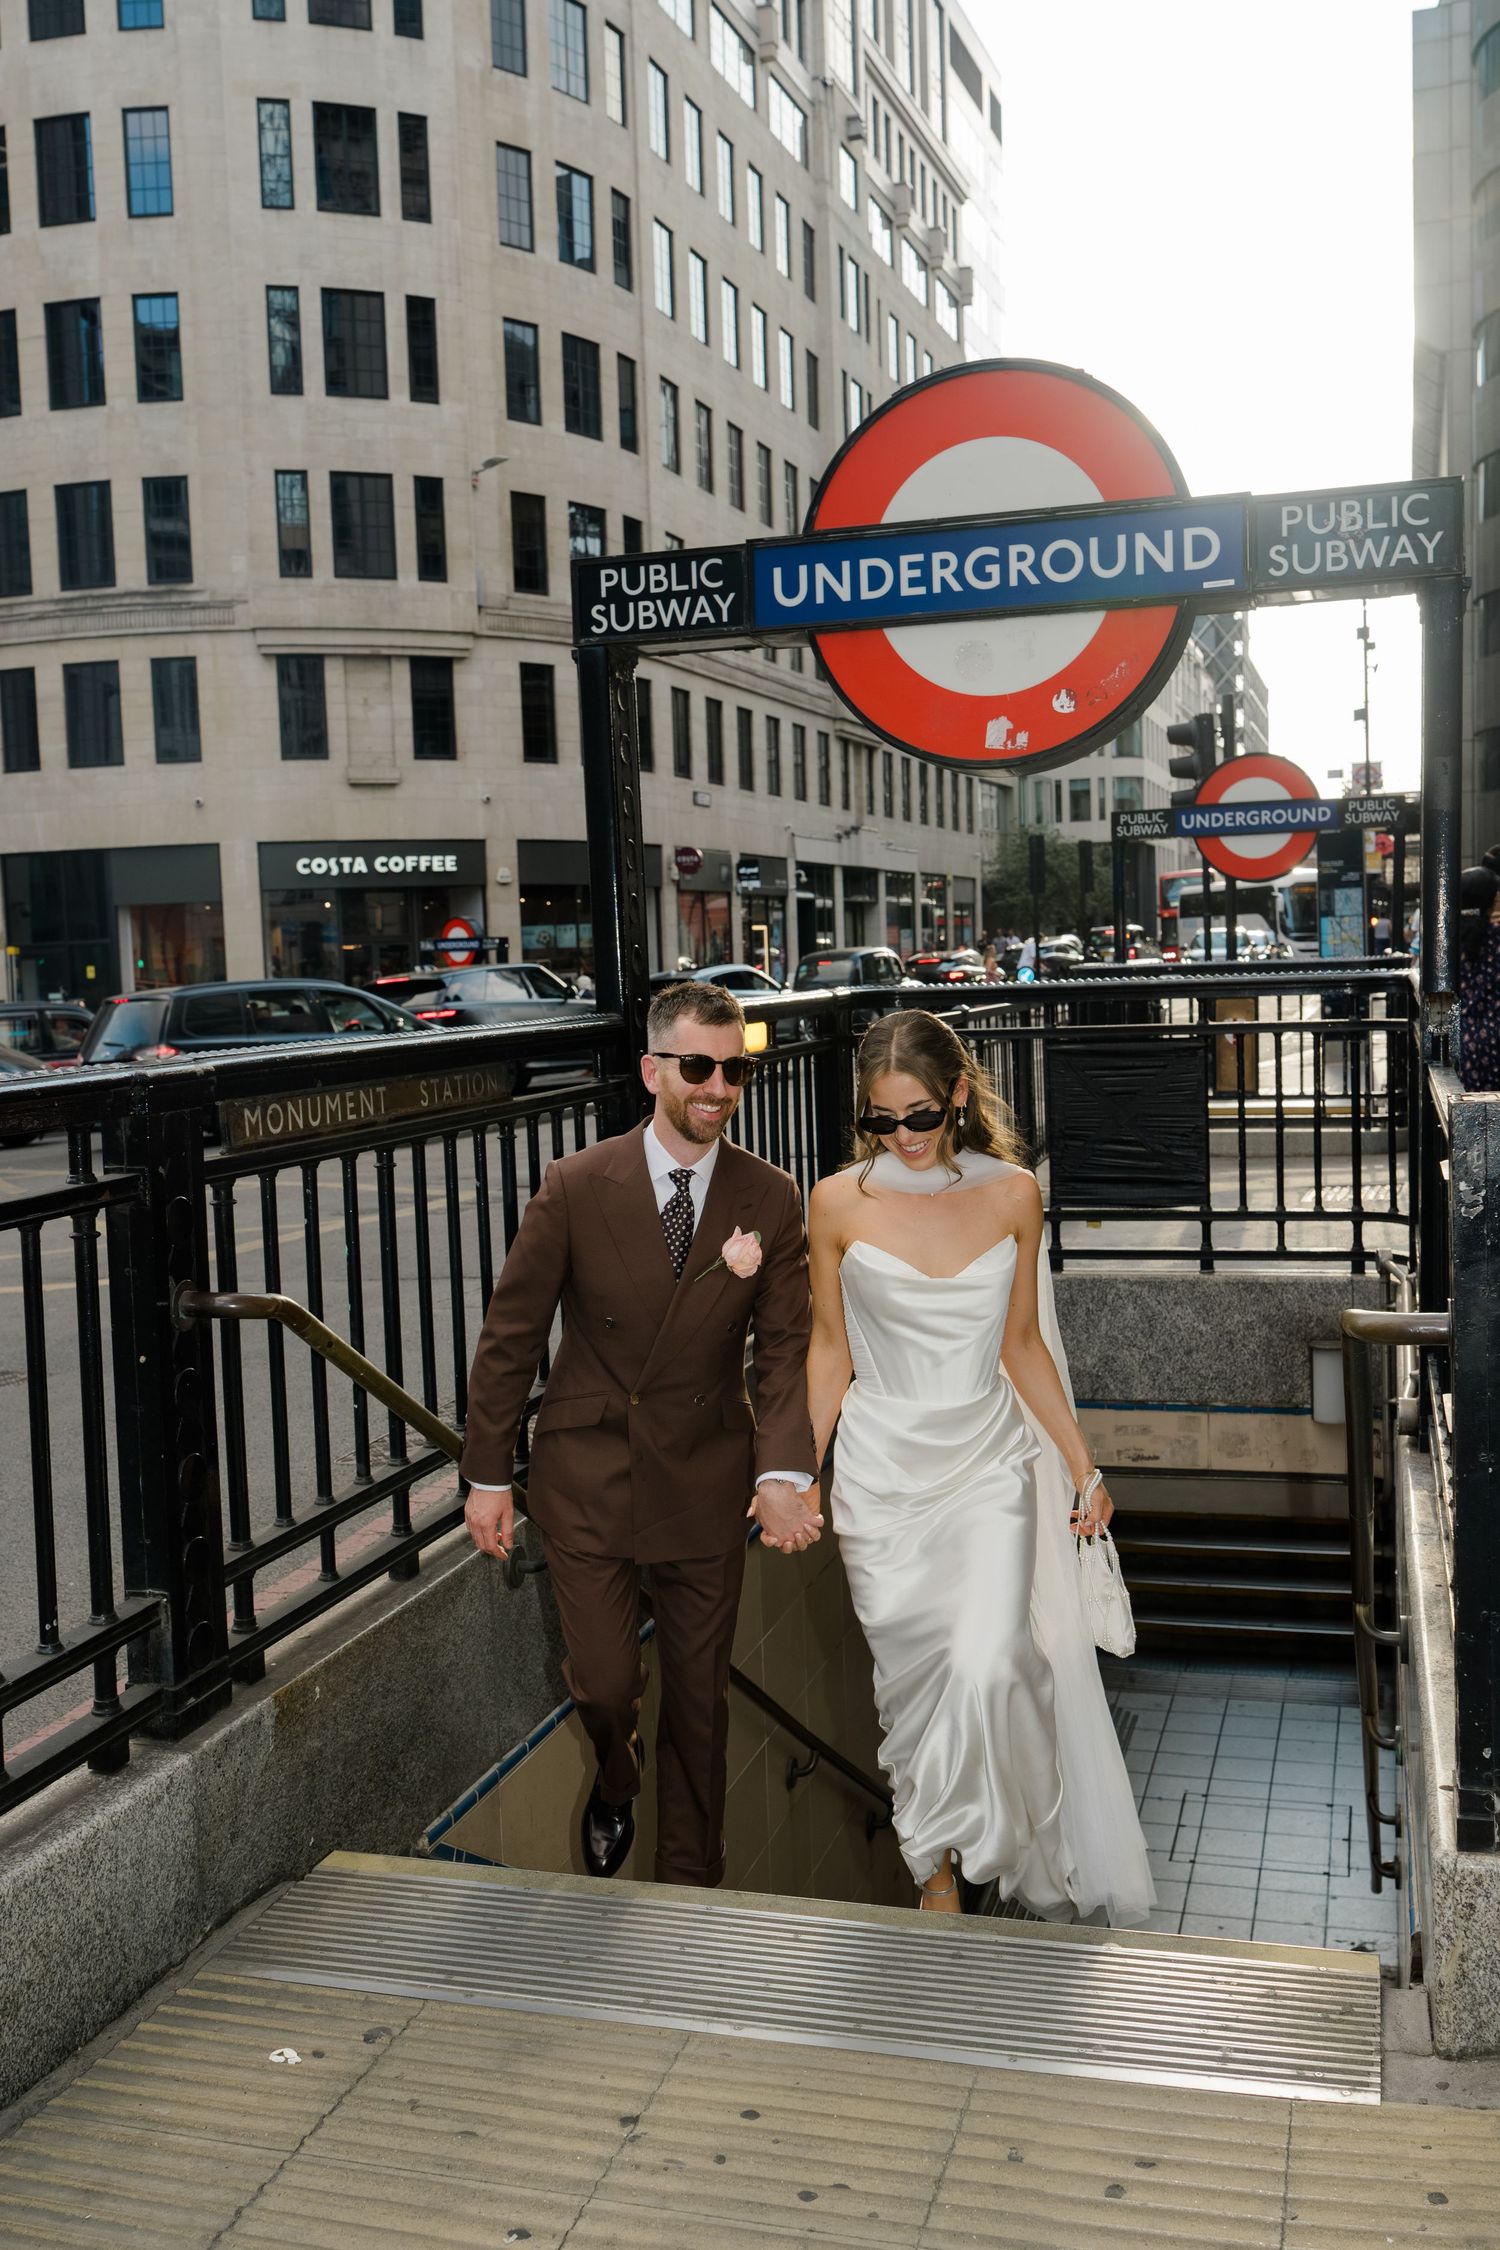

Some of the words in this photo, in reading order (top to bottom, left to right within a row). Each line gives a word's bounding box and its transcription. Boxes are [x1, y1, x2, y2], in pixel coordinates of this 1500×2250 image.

[1281, 493, 1430, 537] PUBLIC
[772, 526, 1221, 608] UNDERGROUND
[1268, 531, 1445, 577] SUBWAY
[599, 557, 724, 599] PUBLIC
[590, 592, 736, 635] SUBWAY
[1119, 811, 1165, 825] PUBLIC
[1181, 807, 1331, 829] UNDERGROUND
[1344, 810, 1401, 824] SUBWAY
[1348, 799, 1396, 812] PUBLIC
[1116, 823, 1169, 837] SUBWAY
[296, 856, 368, 877] COSTA
[374, 855, 458, 873] COFFEE
[243, 1086, 387, 1138] MONUMENT
[419, 1071, 498, 1107] STATION
